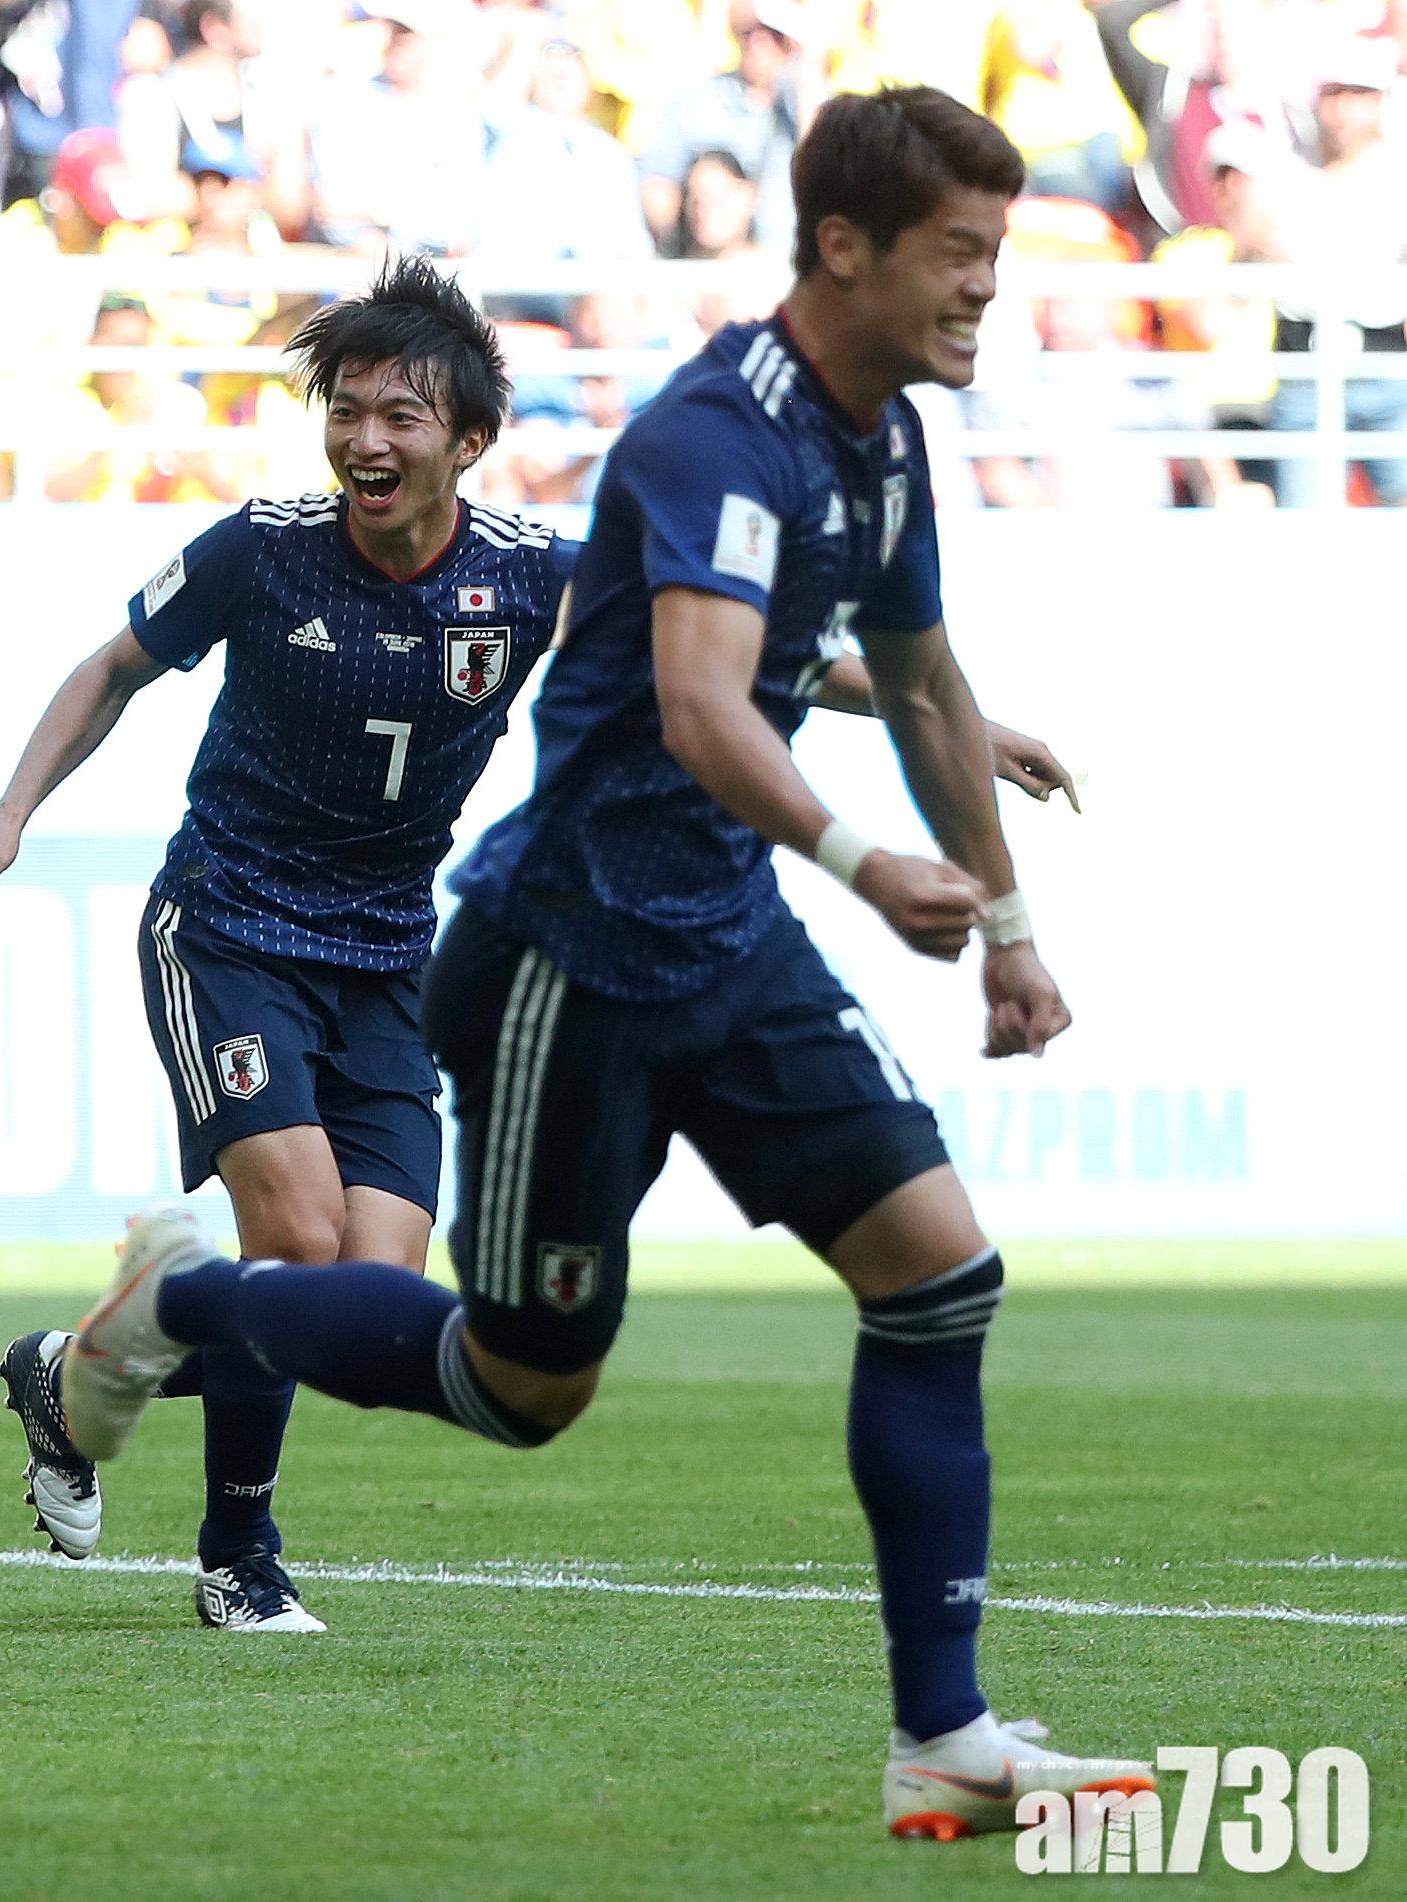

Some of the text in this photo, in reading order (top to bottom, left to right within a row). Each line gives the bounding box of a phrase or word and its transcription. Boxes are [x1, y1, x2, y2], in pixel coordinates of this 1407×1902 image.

[287, 633, 337, 652] adidas
[461, 631, 495, 639] JAPAN
[364, 718, 413, 802] 7
[224, 1471, 279, 1498] JAP
